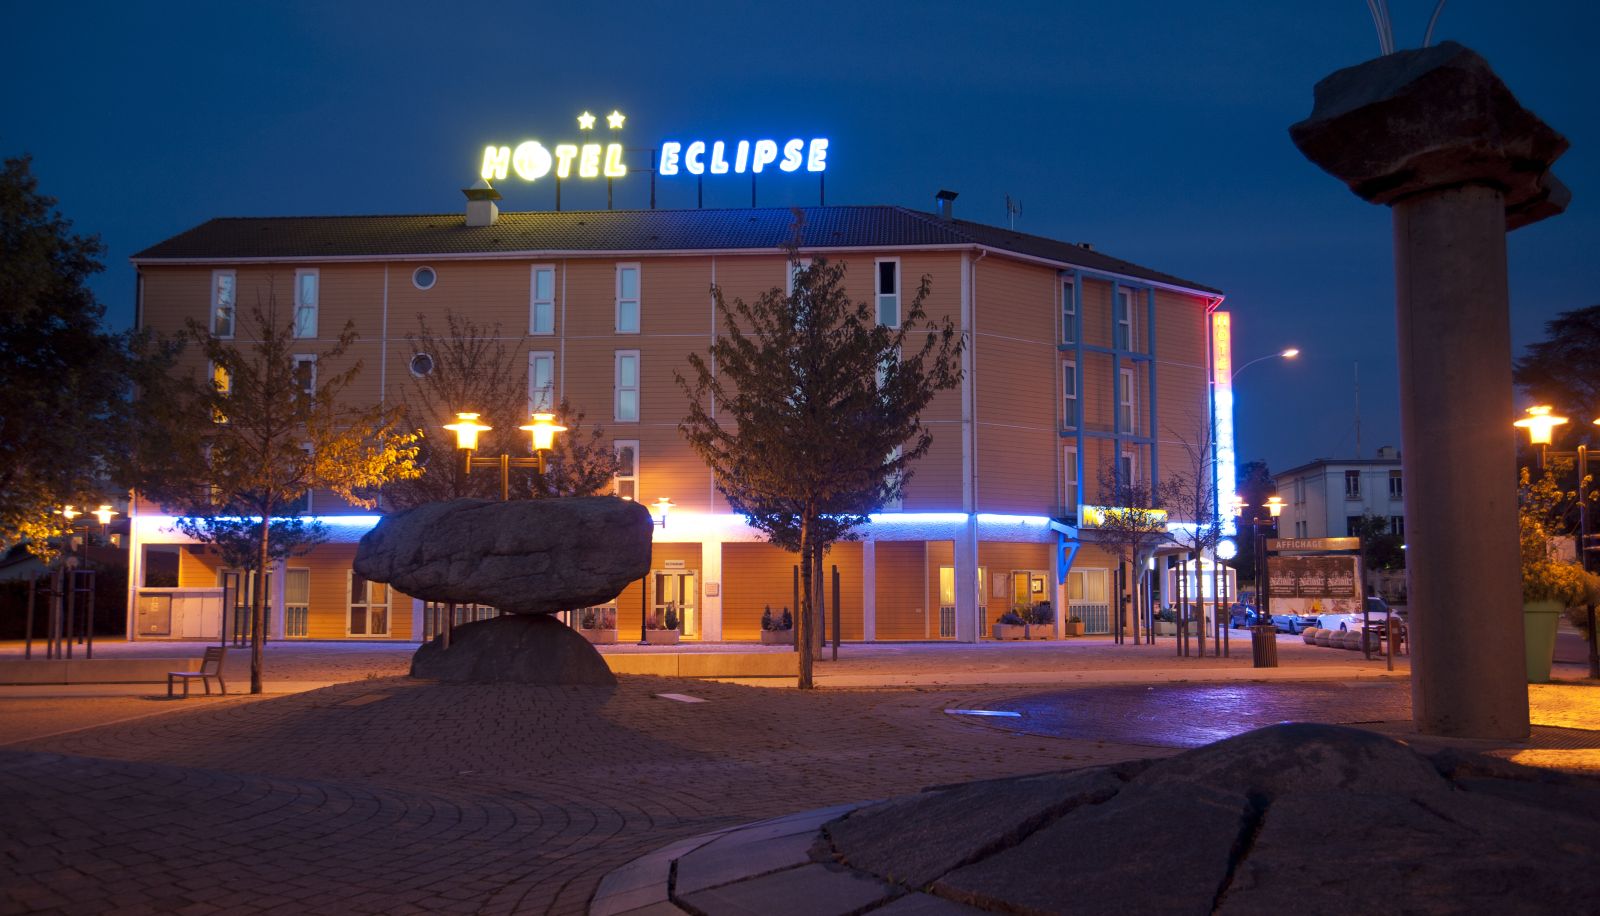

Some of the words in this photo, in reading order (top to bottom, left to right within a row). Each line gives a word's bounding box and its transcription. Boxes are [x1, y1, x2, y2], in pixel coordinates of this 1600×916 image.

[481, 141, 627, 181] HOTEL
[659, 138, 829, 176] ECLIPSE
[1275, 540, 1323, 549] AFFICHAGE
